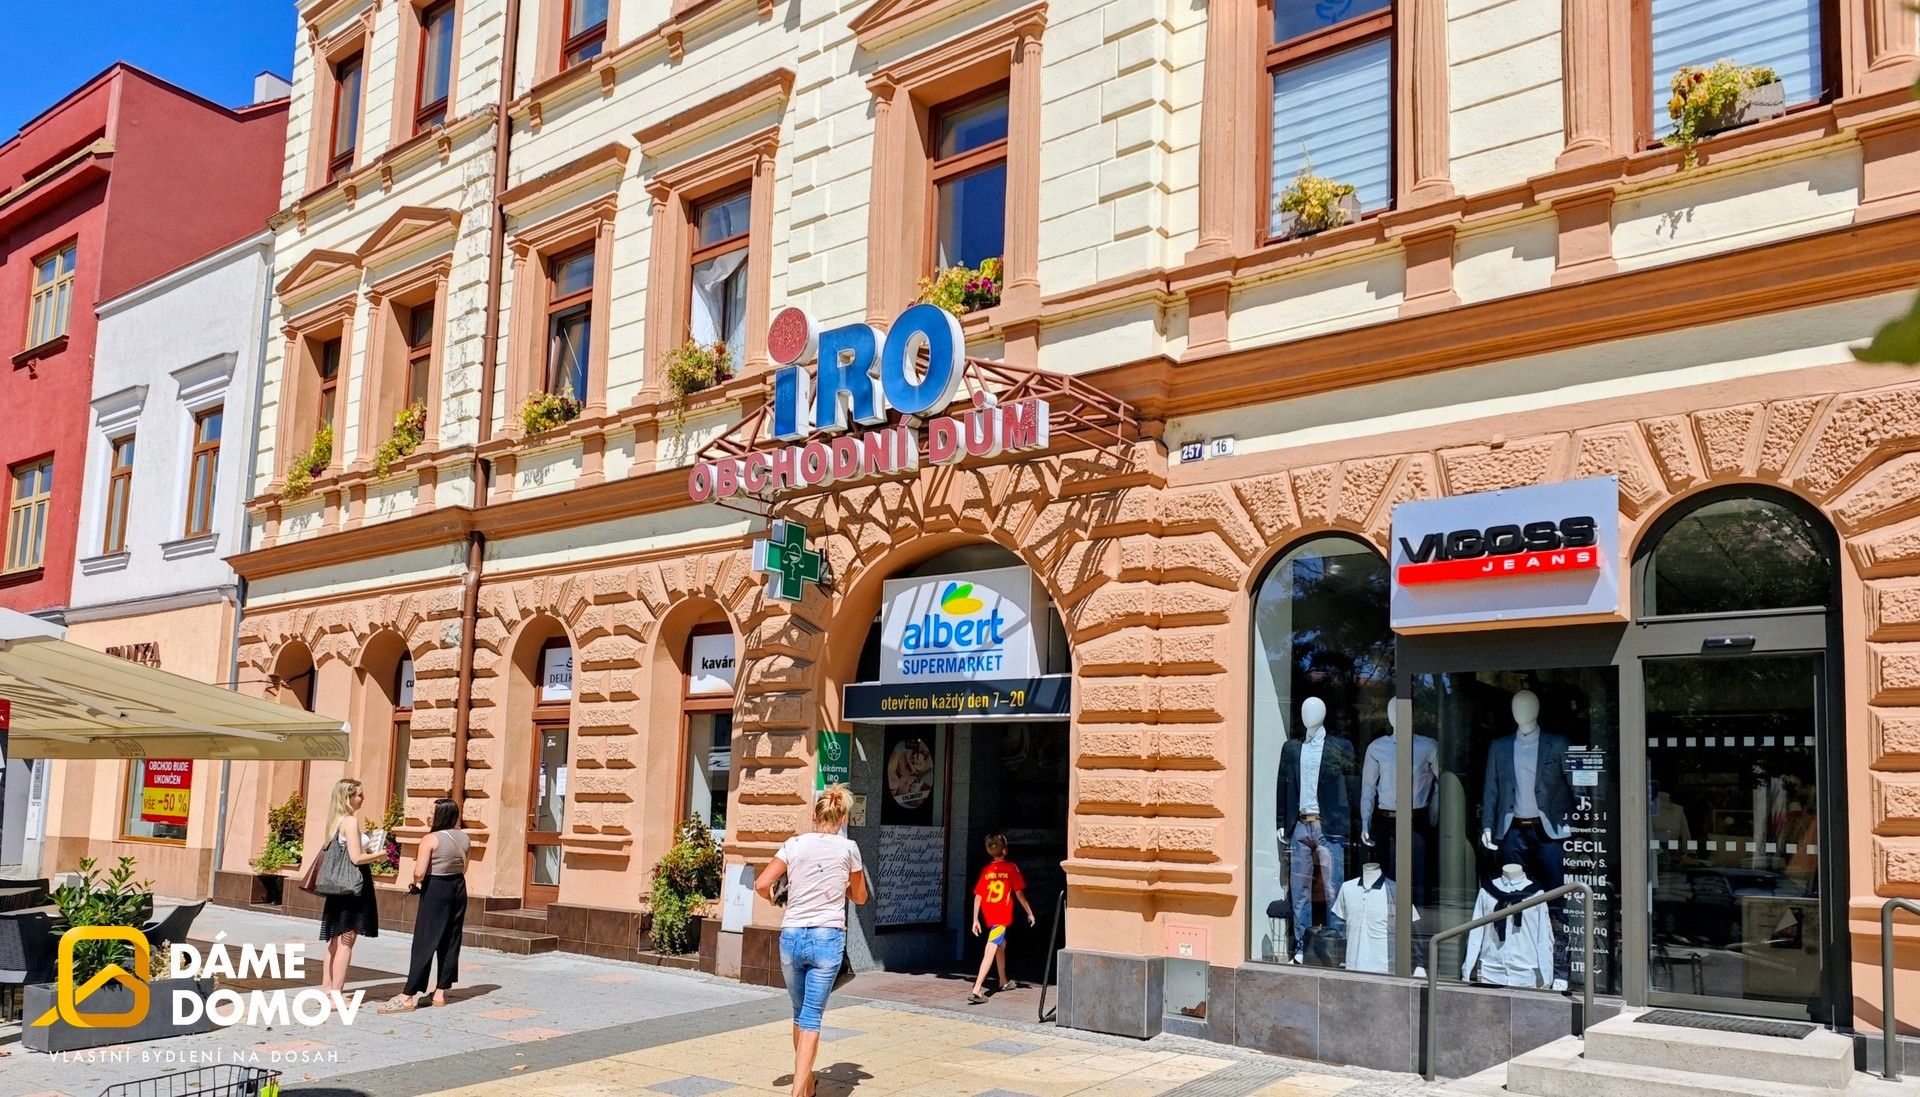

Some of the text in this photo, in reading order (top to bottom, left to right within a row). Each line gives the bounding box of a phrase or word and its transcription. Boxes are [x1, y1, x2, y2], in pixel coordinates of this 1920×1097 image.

[688, 390, 1048, 502] OBCHODNÍ DŮM
[1182, 443, 1201, 460] 257
[1216, 440, 1227, 453] 16
[1399, 516, 1597, 564] VIGOSS
[1482, 551, 1590, 572] JEANS
[904, 609, 1004, 650] albert
[903, 655, 1003, 675] SUPERMARKET
[881, 694, 928, 711] otevřeno
[931, 692, 964, 712] každý
[967, 693, 989, 709] den
[148, 761, 189, 771] OBCHOD BUDE
[153, 773, 181, 785] UKONČEN
[144, 796, 156, 810] VŠE
[178, 794, 187, 813] %
[1562, 840, 1607, 853] CECIL
[1563, 857, 1607, 869] Kenny S.
[986, 880, 1004, 903] 19
[1573, 892, 1608, 901] GACIA
